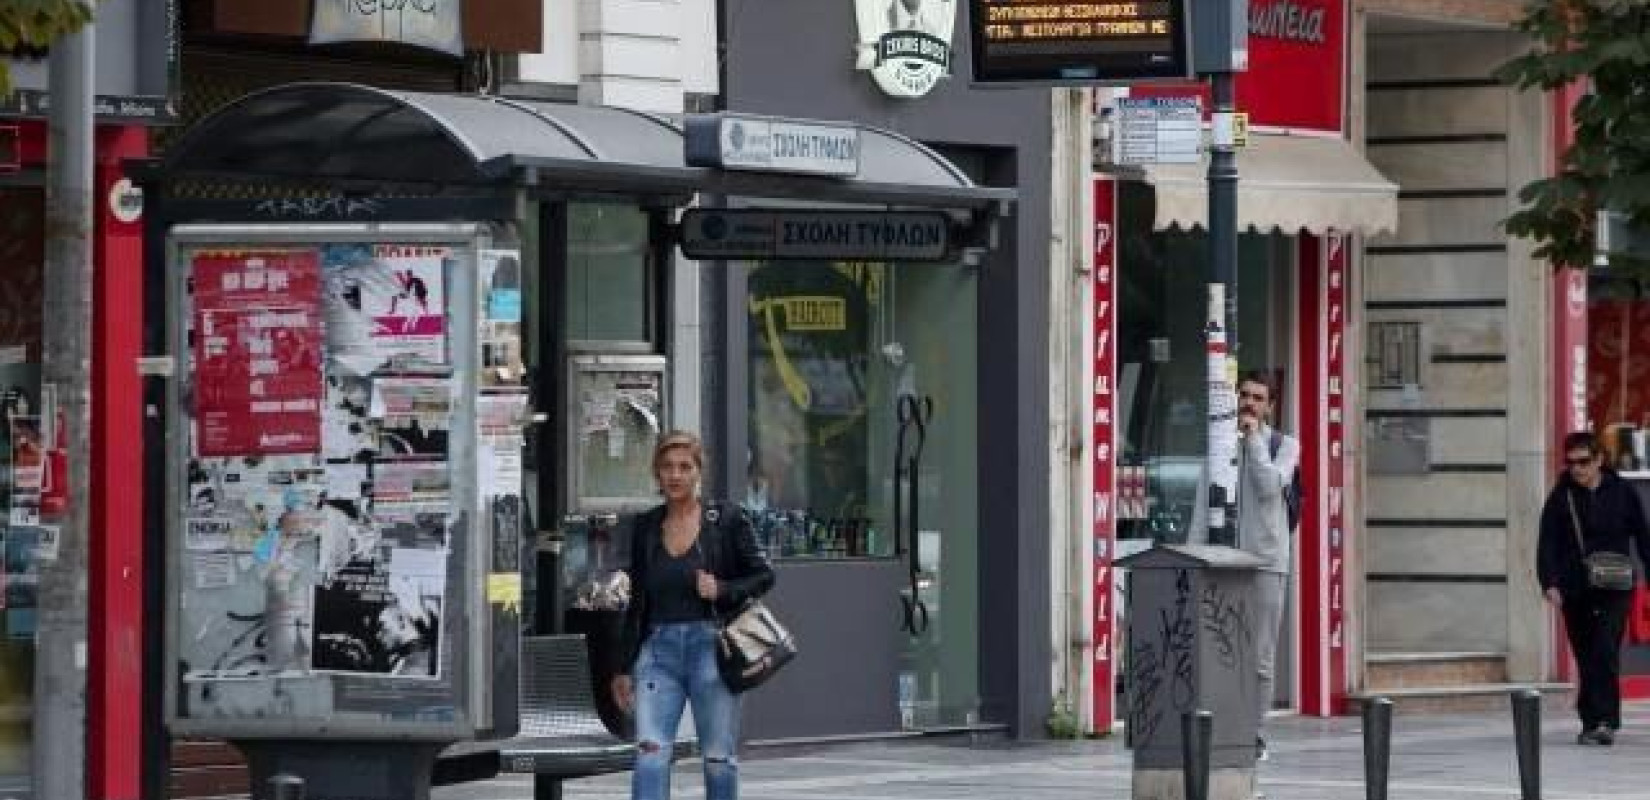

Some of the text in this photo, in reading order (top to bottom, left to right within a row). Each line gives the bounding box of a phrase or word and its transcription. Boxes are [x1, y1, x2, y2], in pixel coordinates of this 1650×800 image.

[783, 218, 850, 246] ΣΧΟΛΗ
[856, 218, 940, 247] ΤΥΦΛΩΝ
[1094, 222, 1111, 661] Perfume World
